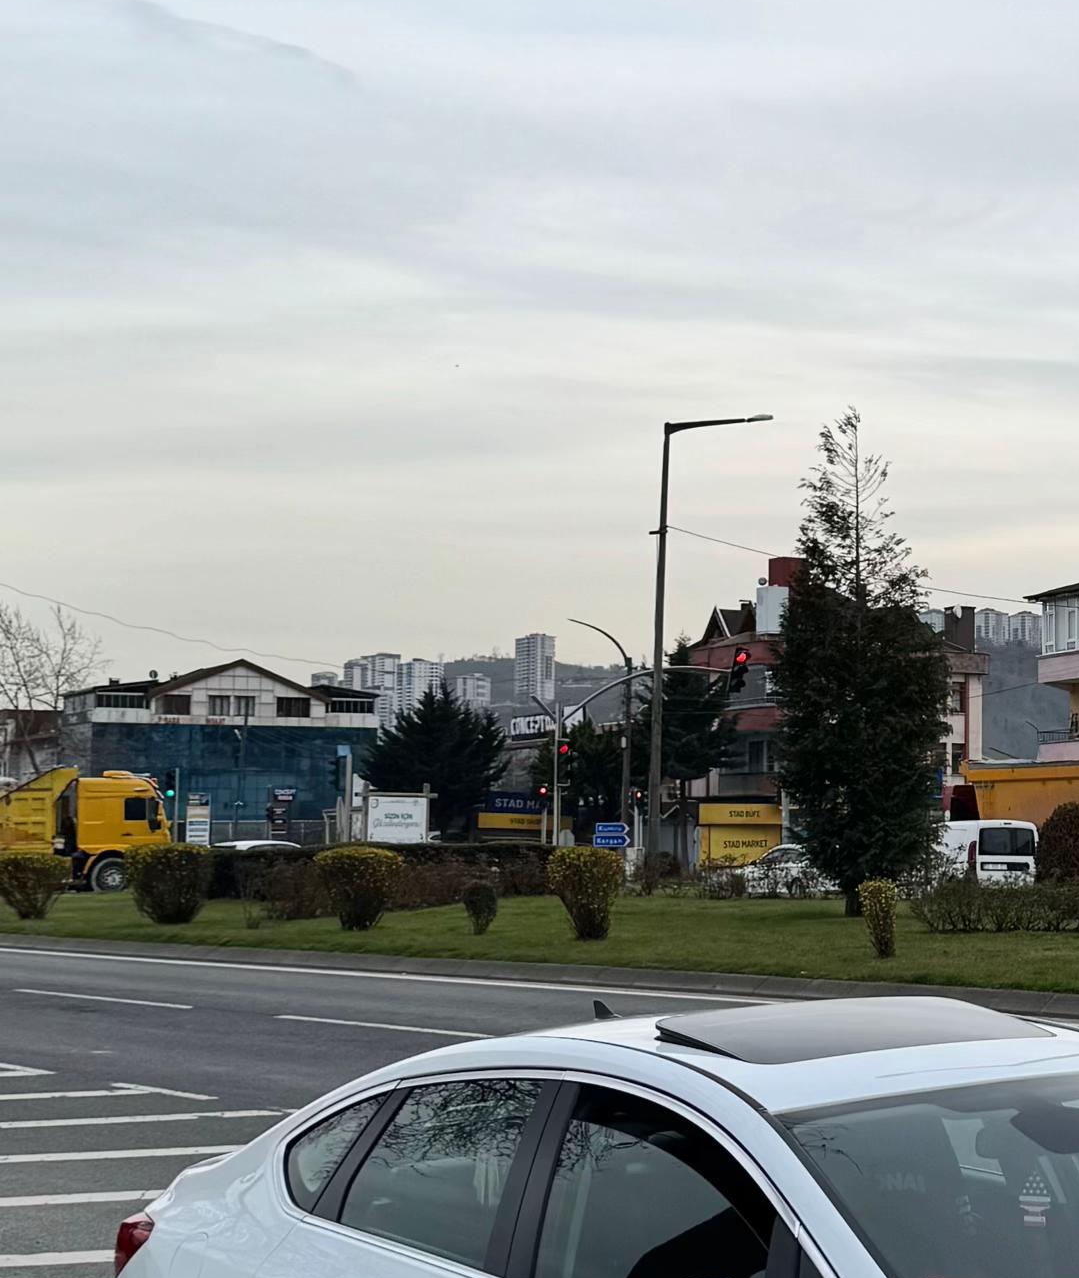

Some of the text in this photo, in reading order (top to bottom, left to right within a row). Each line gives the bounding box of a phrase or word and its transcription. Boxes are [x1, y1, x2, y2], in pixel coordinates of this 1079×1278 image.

[494, 798, 524, 809] STAD
[728, 810, 744, 818] STAD
[723, 839, 768, 849] STAD MARKET
